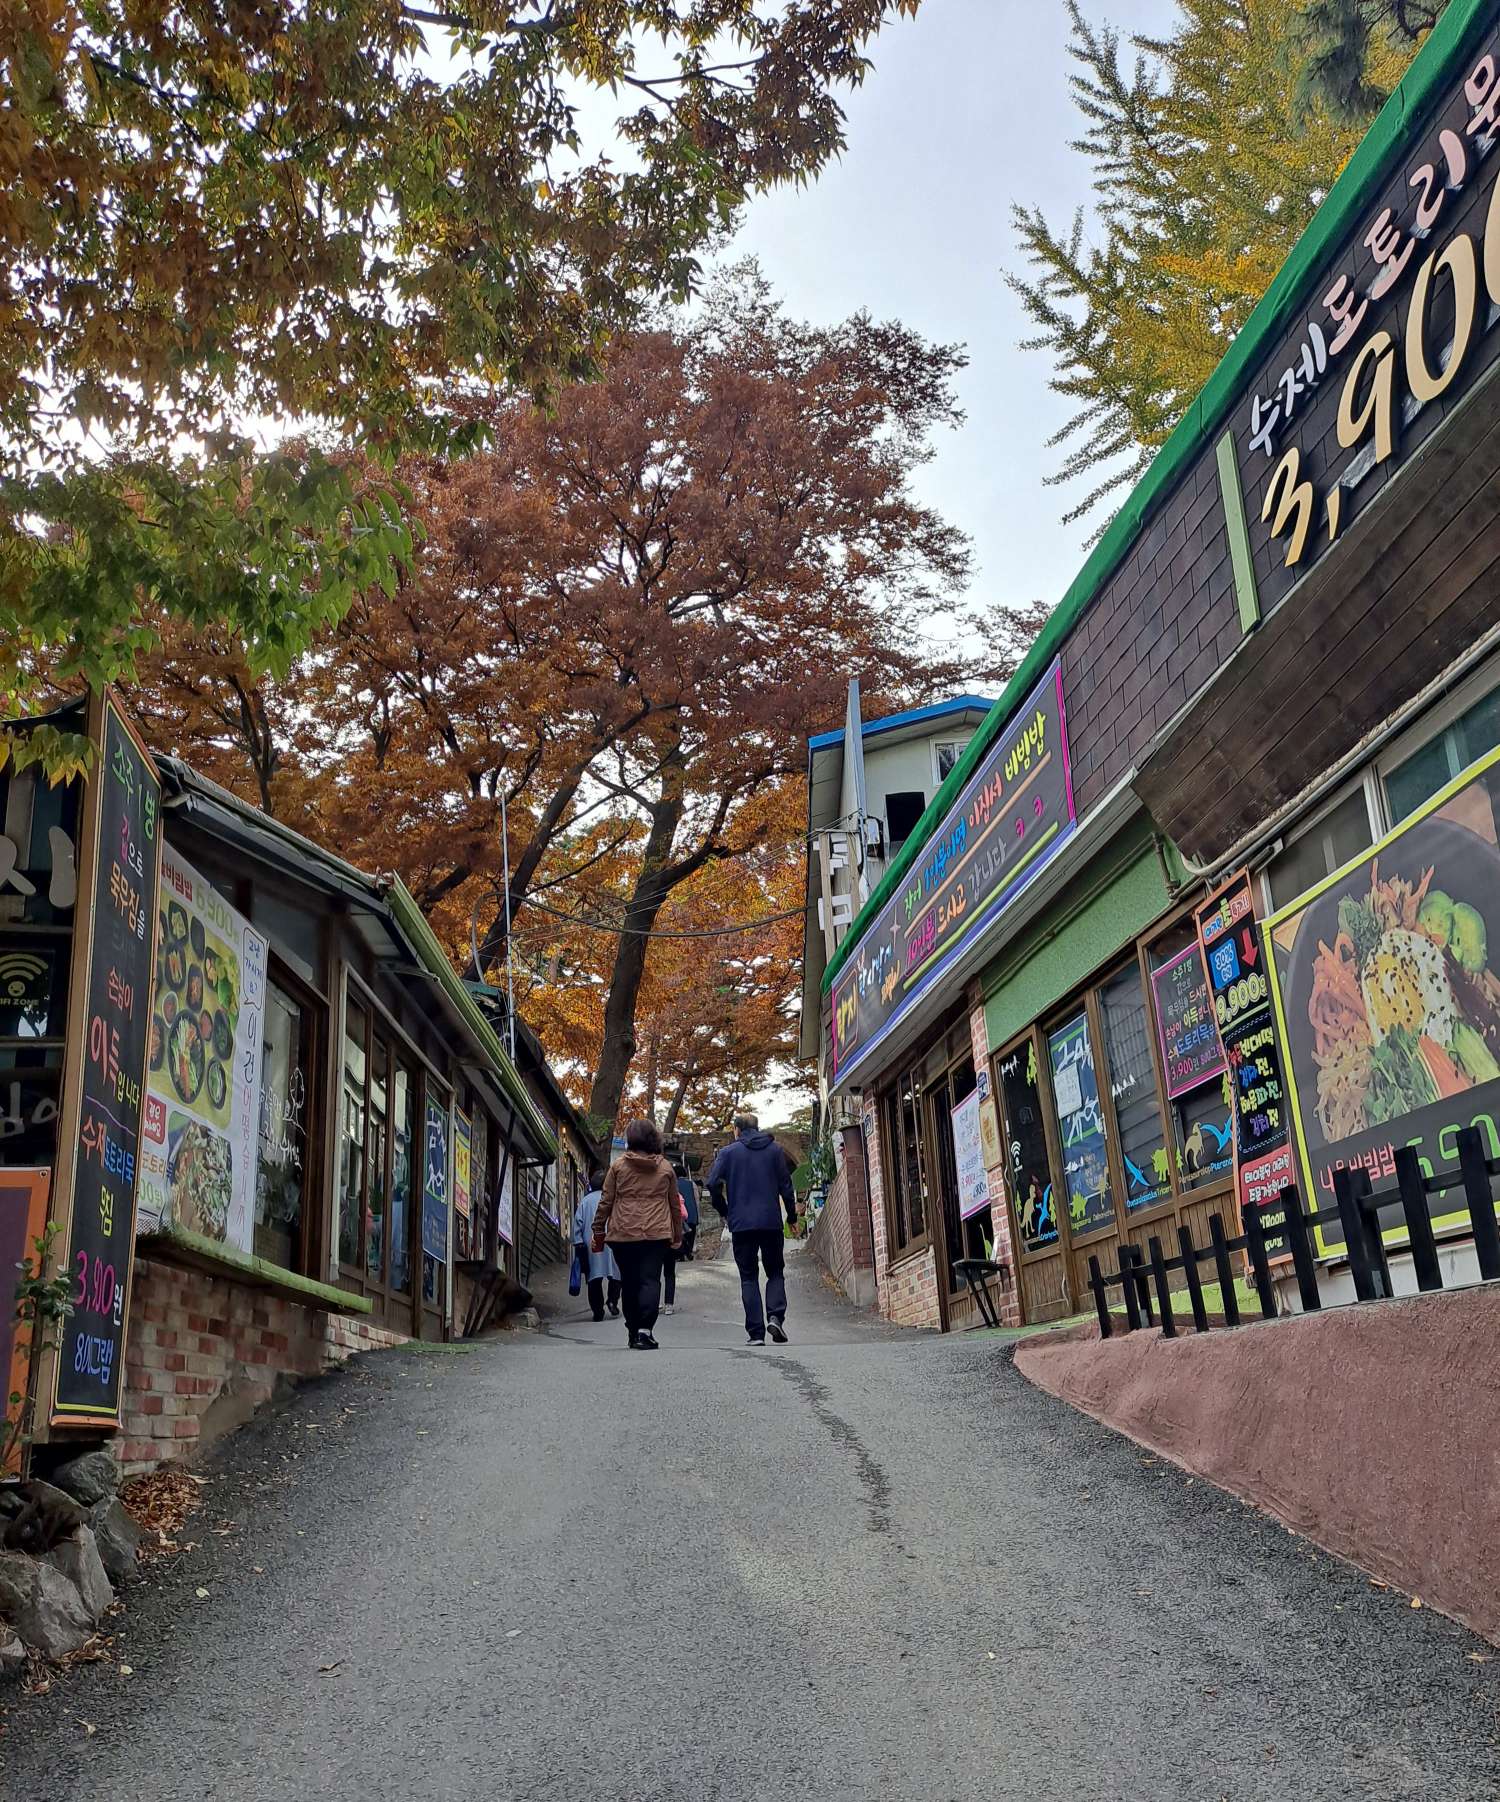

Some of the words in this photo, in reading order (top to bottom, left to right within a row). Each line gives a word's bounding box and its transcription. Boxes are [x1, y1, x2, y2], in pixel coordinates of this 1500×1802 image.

[1261, 165, 1500, 567] 3,90
[1214, 945, 1233, 969] 30%
[1184, 1006, 1211, 1029] 이득입니
